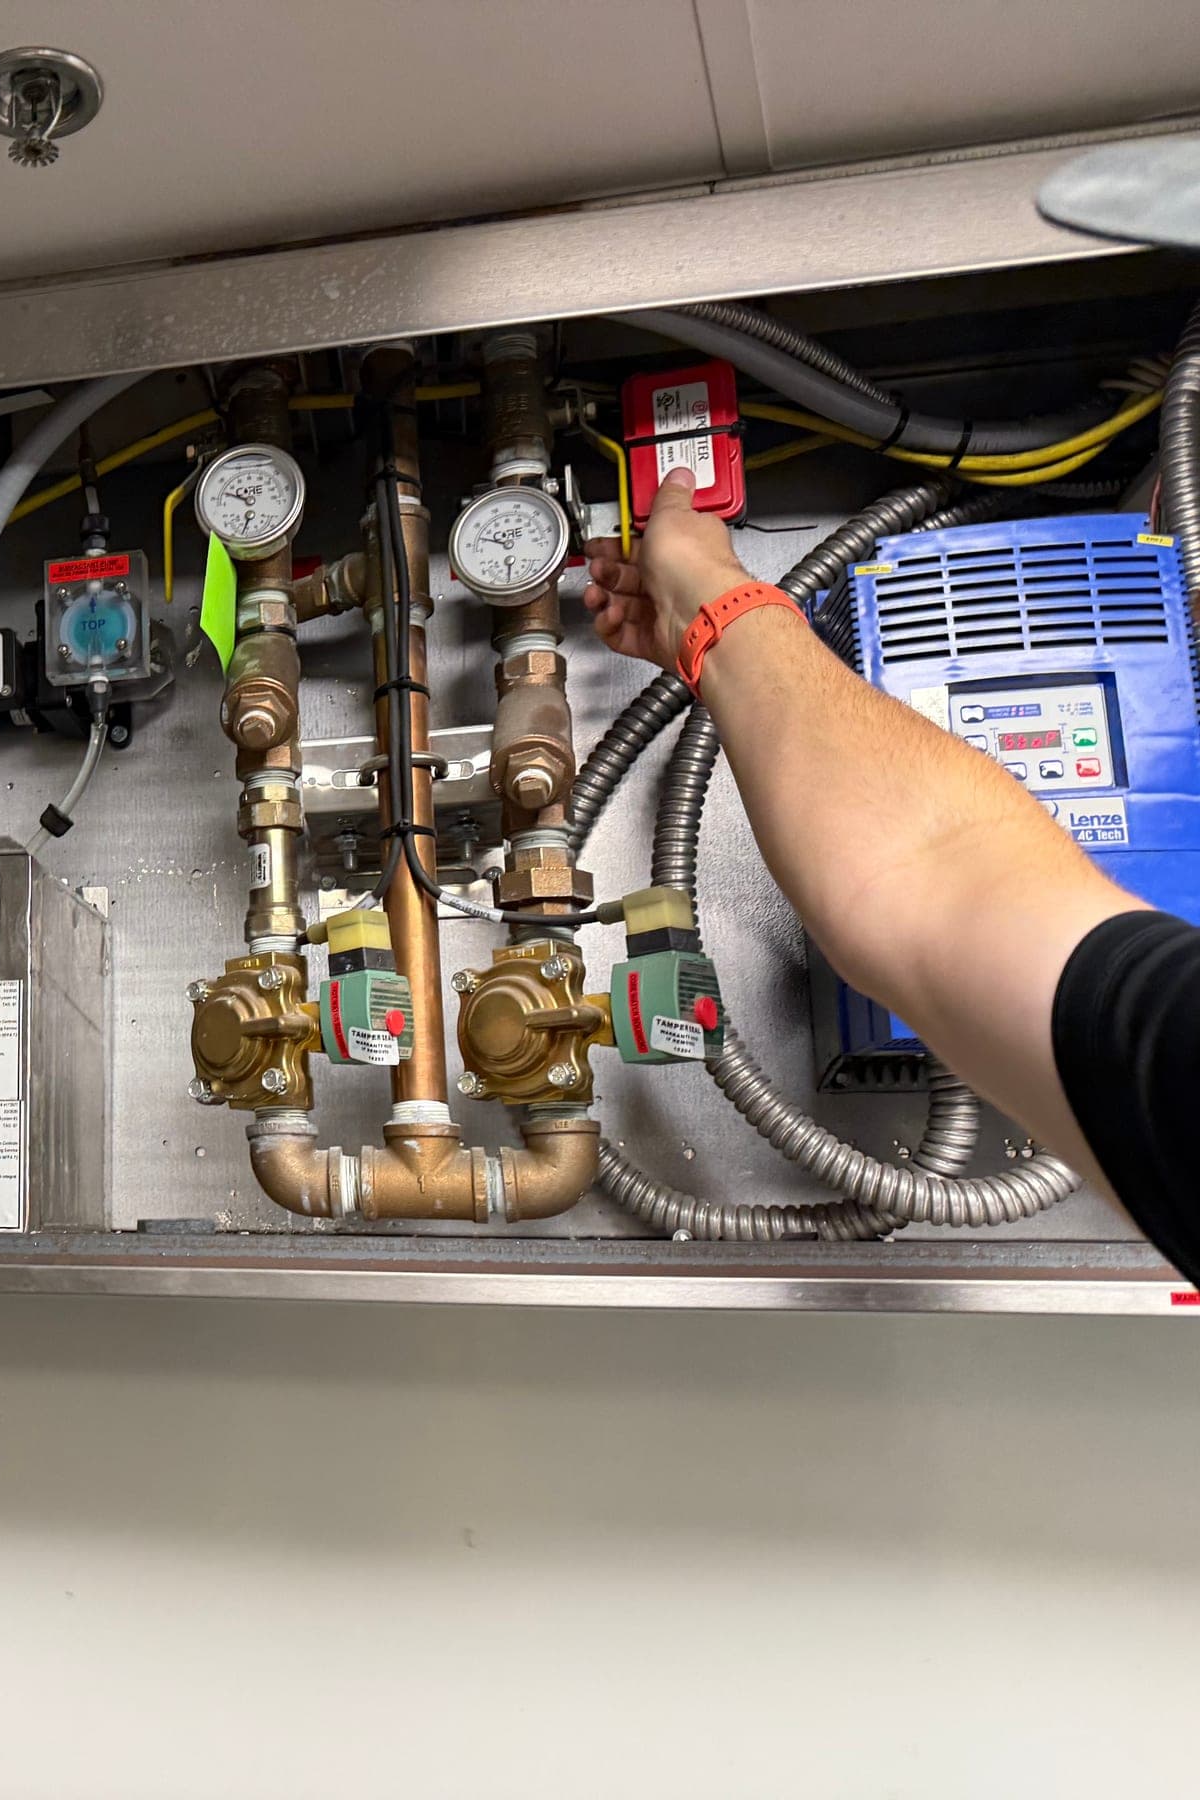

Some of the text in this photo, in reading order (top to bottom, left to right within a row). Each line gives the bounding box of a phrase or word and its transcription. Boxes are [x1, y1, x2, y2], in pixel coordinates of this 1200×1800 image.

[695, 415, 709, 461] POTER
[236, 485, 263, 497] CORE
[493, 527, 522, 541] CORE
[81, 619, 105, 631] TOP
[1070, 812, 1123, 827] Lenze
[1077, 828, 1122, 840] AC Tech
[656, 1018, 688, 1030] TAMPER
[352, 1030, 380, 1040] TAMPER
